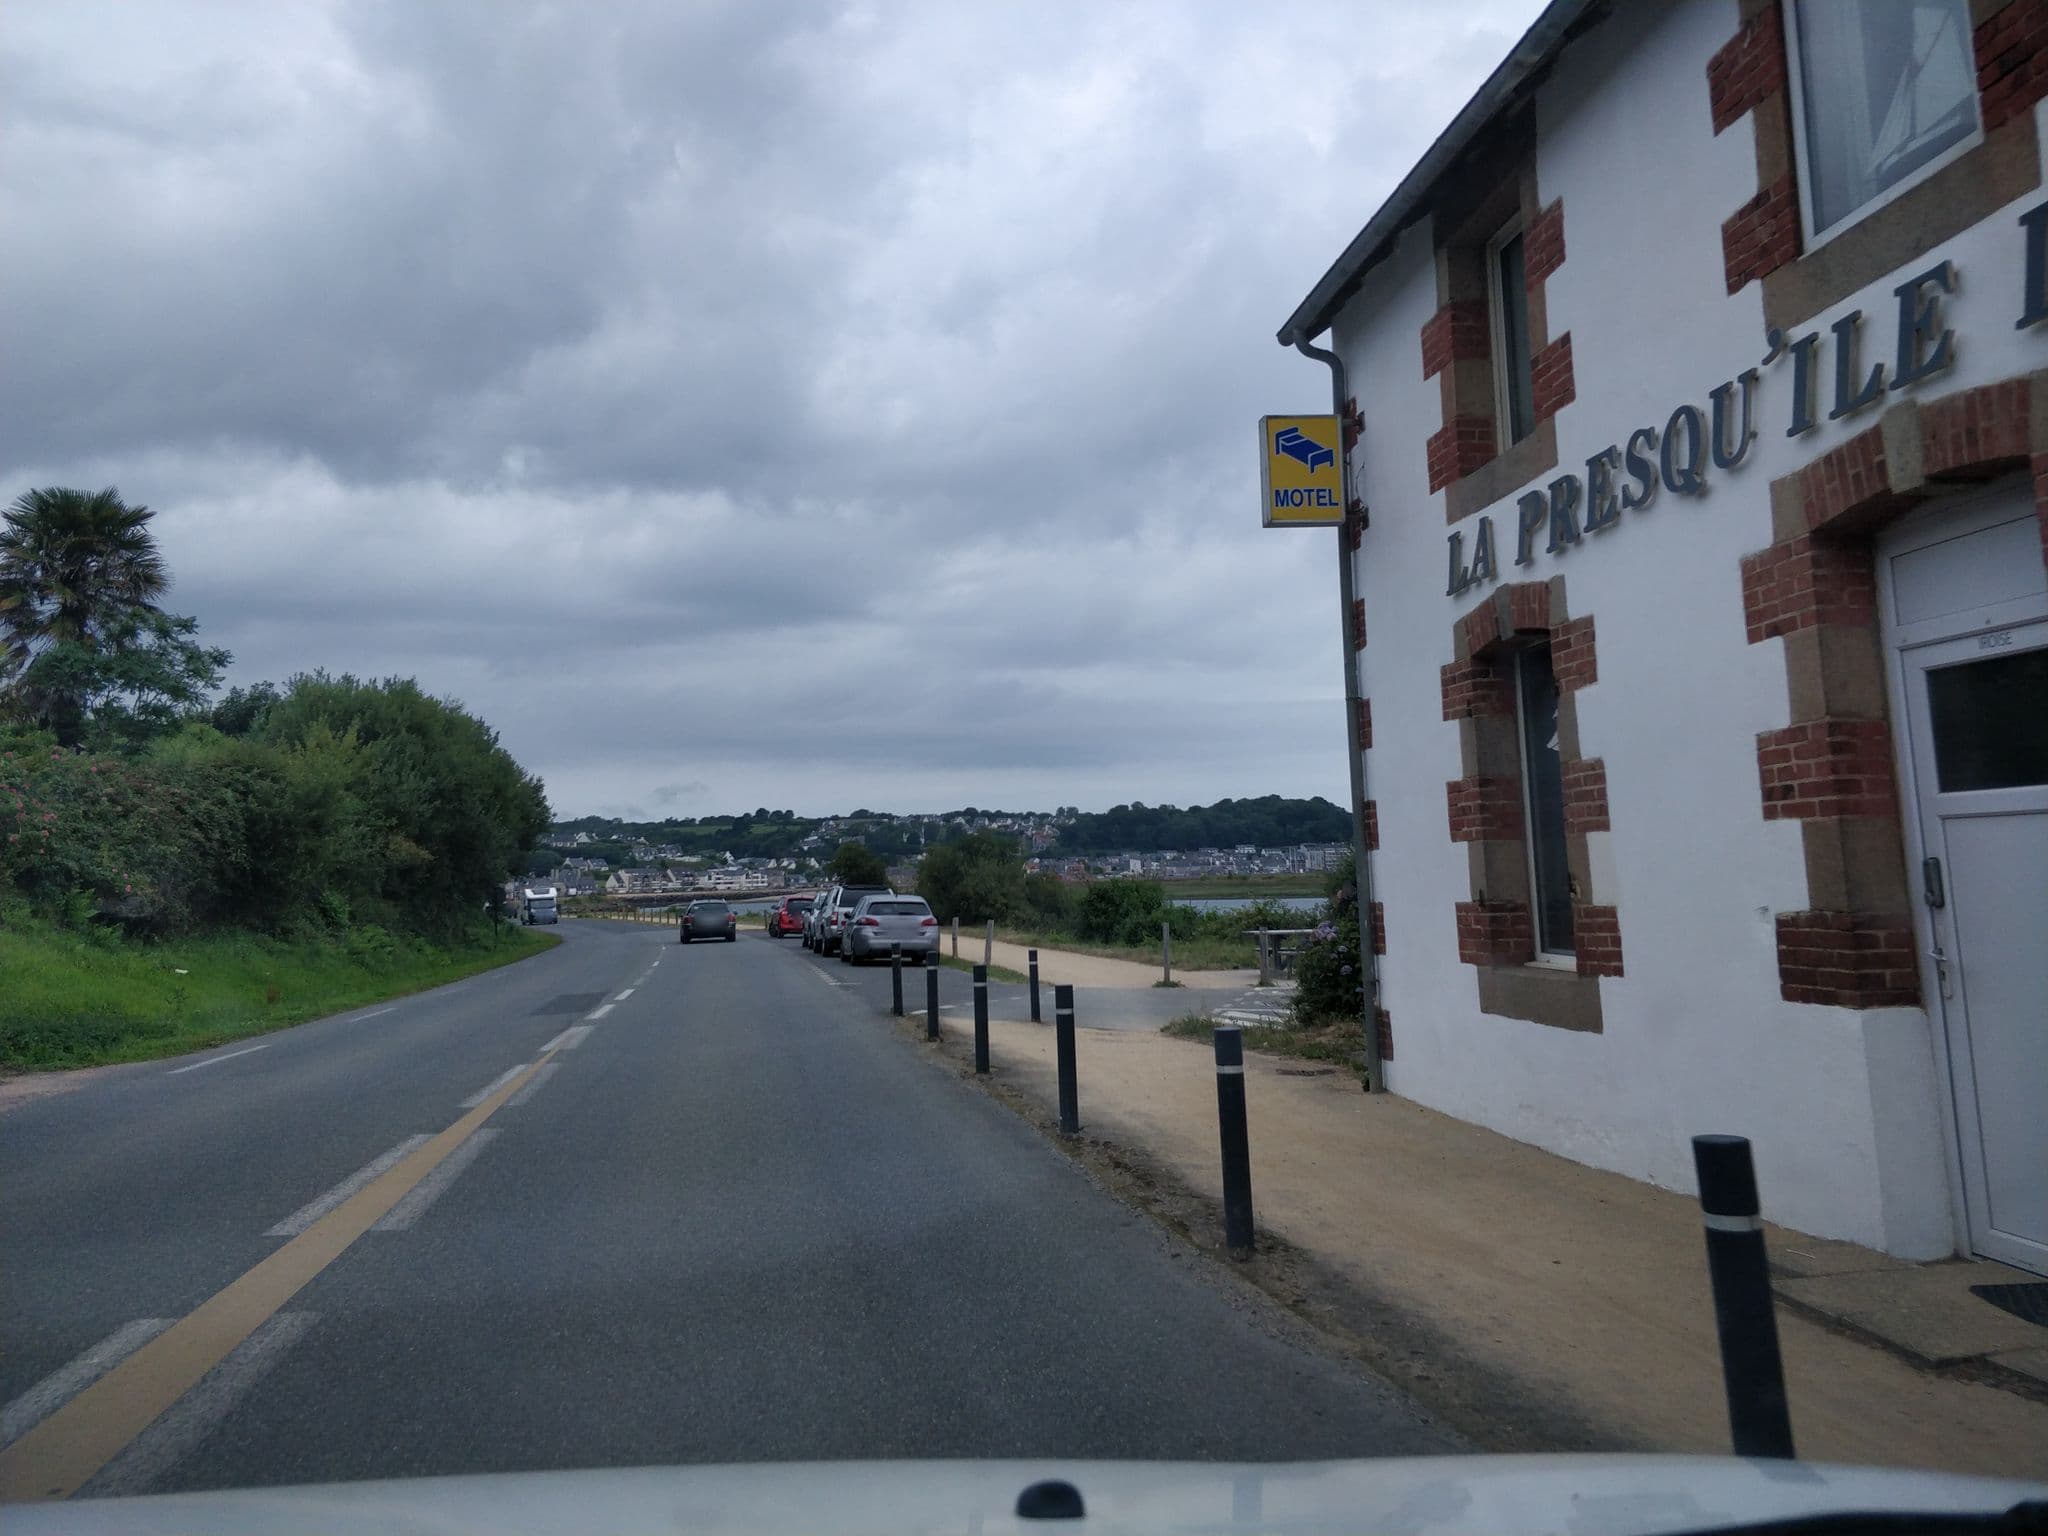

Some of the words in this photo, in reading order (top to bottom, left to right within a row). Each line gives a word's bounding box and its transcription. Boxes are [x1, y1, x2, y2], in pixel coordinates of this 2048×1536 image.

[1275, 488, 1339, 507] MOTEL
[1447, 517, 1494, 596] LA
[1515, 259, 1955, 566] PRESQU'ILE
